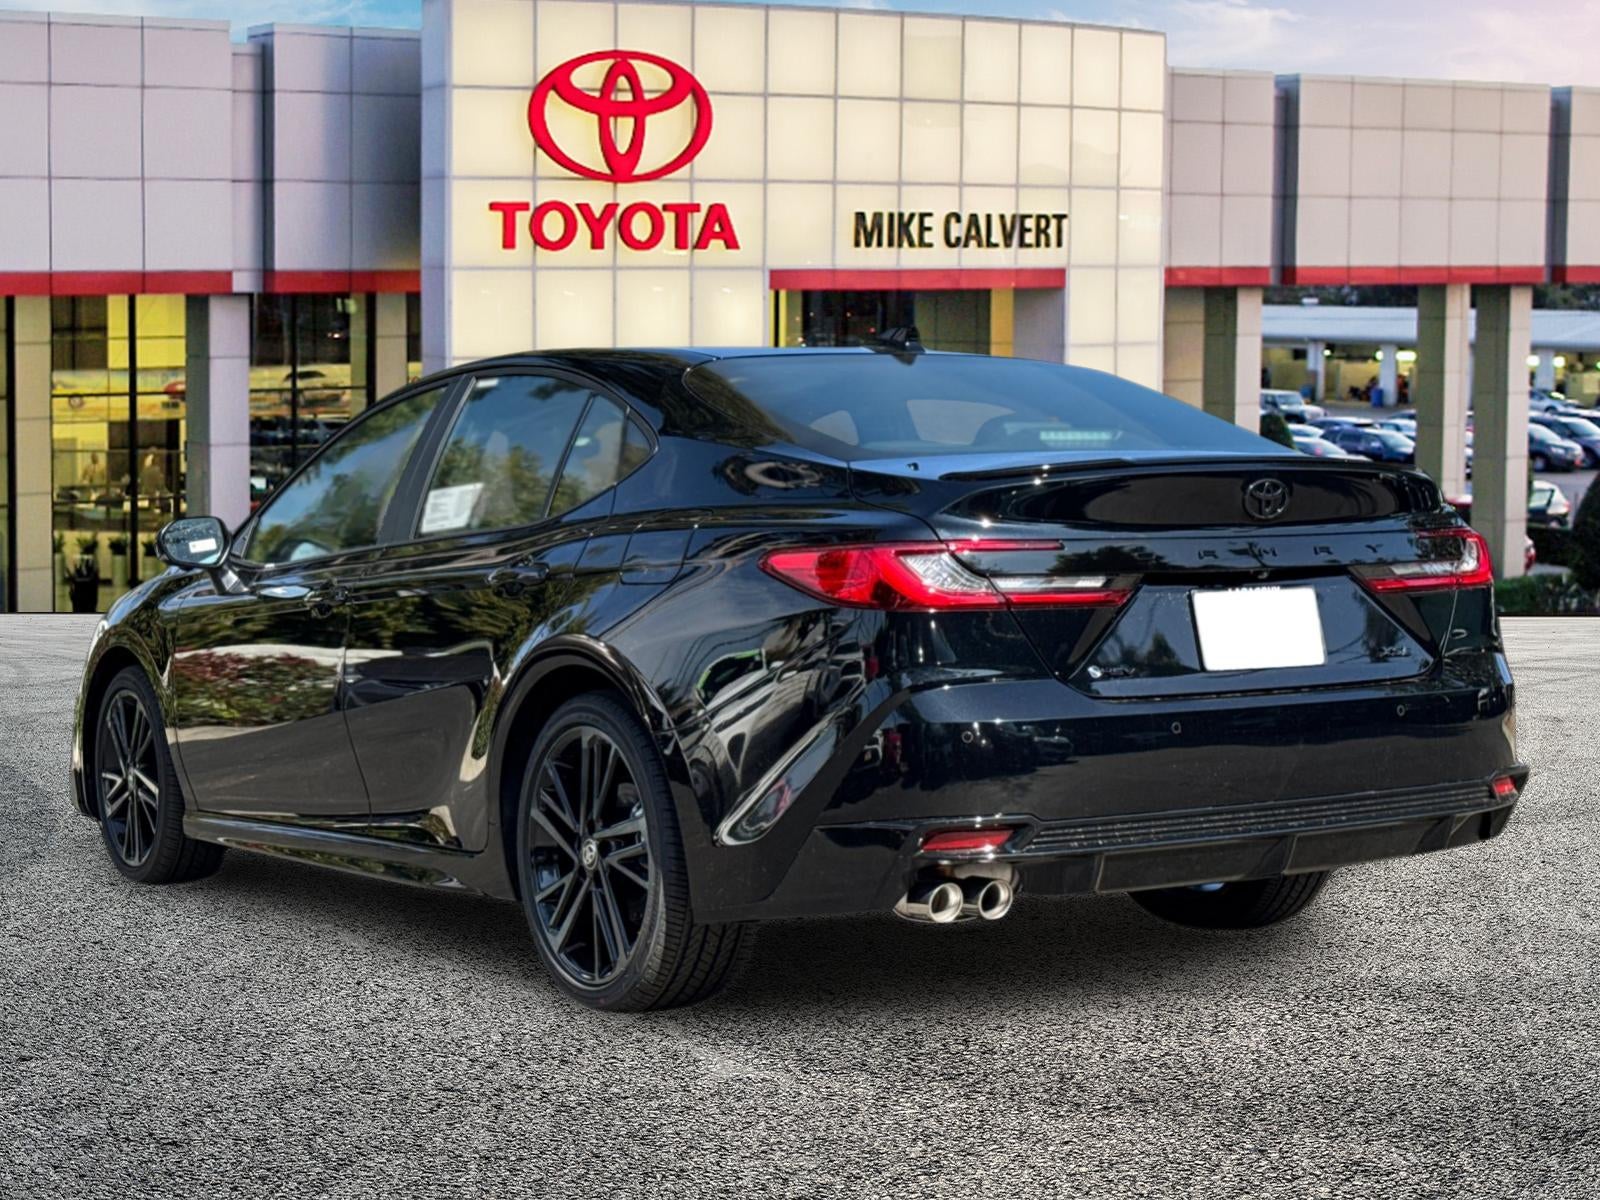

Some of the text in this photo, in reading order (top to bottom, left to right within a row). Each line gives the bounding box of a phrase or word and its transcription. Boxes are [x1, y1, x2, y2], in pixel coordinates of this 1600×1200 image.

[489, 200, 740, 251] TOYOTA
[853, 211, 1069, 249] MIKE CALVERT
